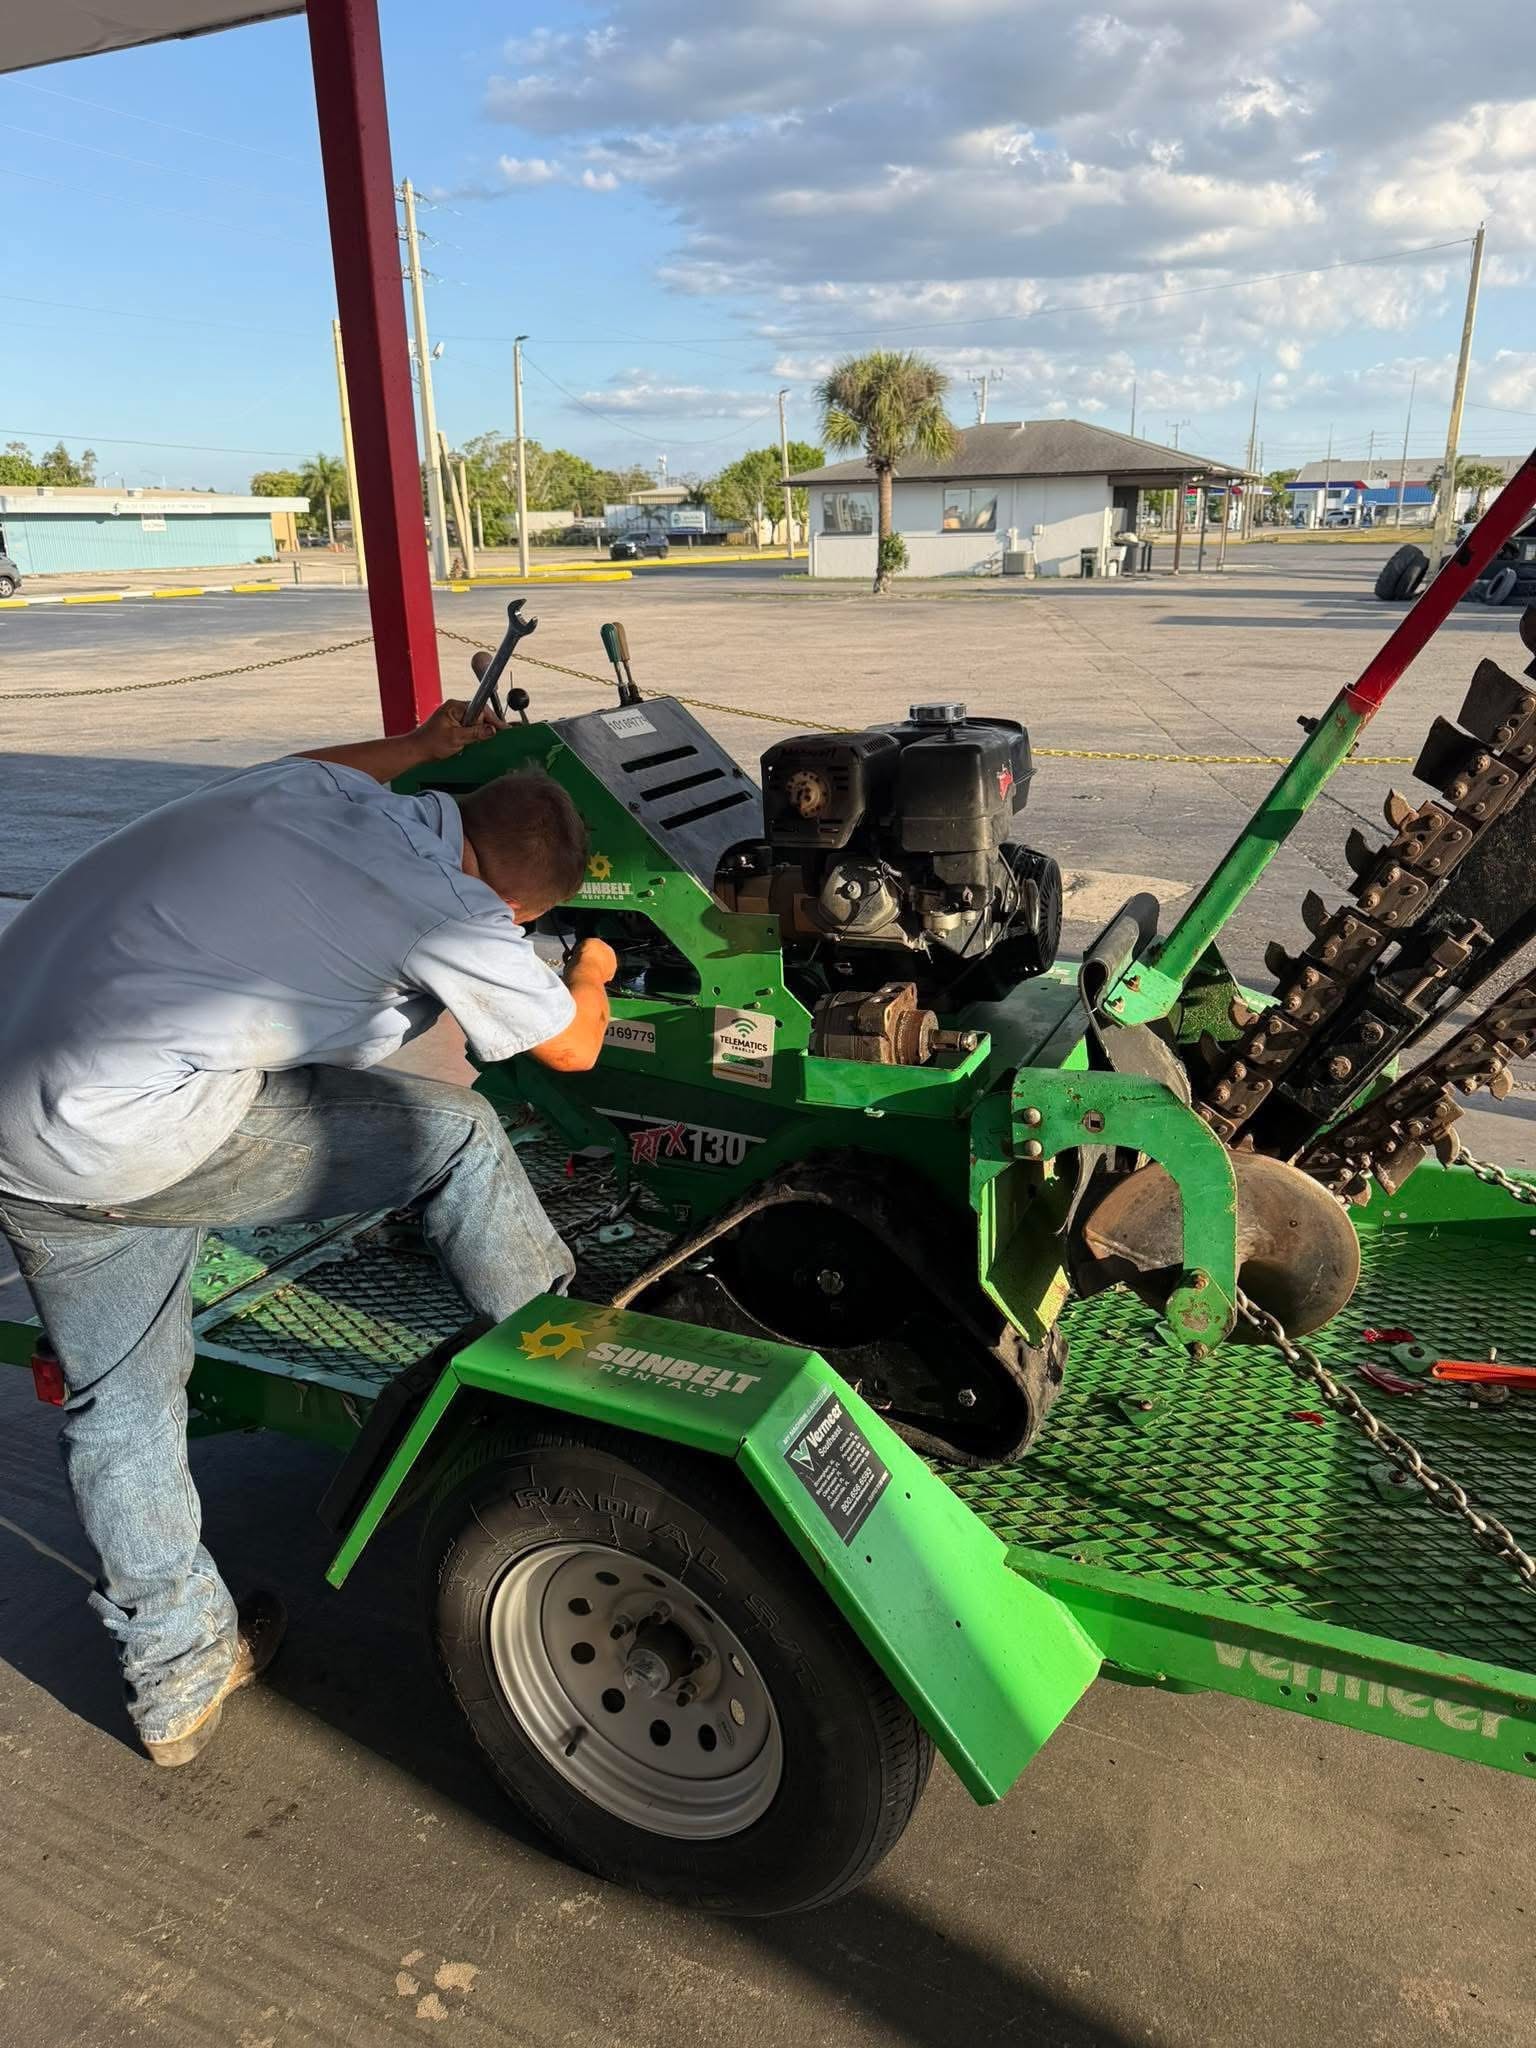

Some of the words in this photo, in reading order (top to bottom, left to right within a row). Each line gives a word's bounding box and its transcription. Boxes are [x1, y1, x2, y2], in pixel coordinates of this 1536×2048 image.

[719, 1034, 768, 1052] TELEMATICS
[587, 1342, 761, 1395] SUNBELT
[599, 1363, 718, 1399] RENTALS
[807, 1402, 842, 1448] Vermeer
[818, 1425, 842, 1457] Southeast
[512, 1486, 729, 1585] RADIAL
